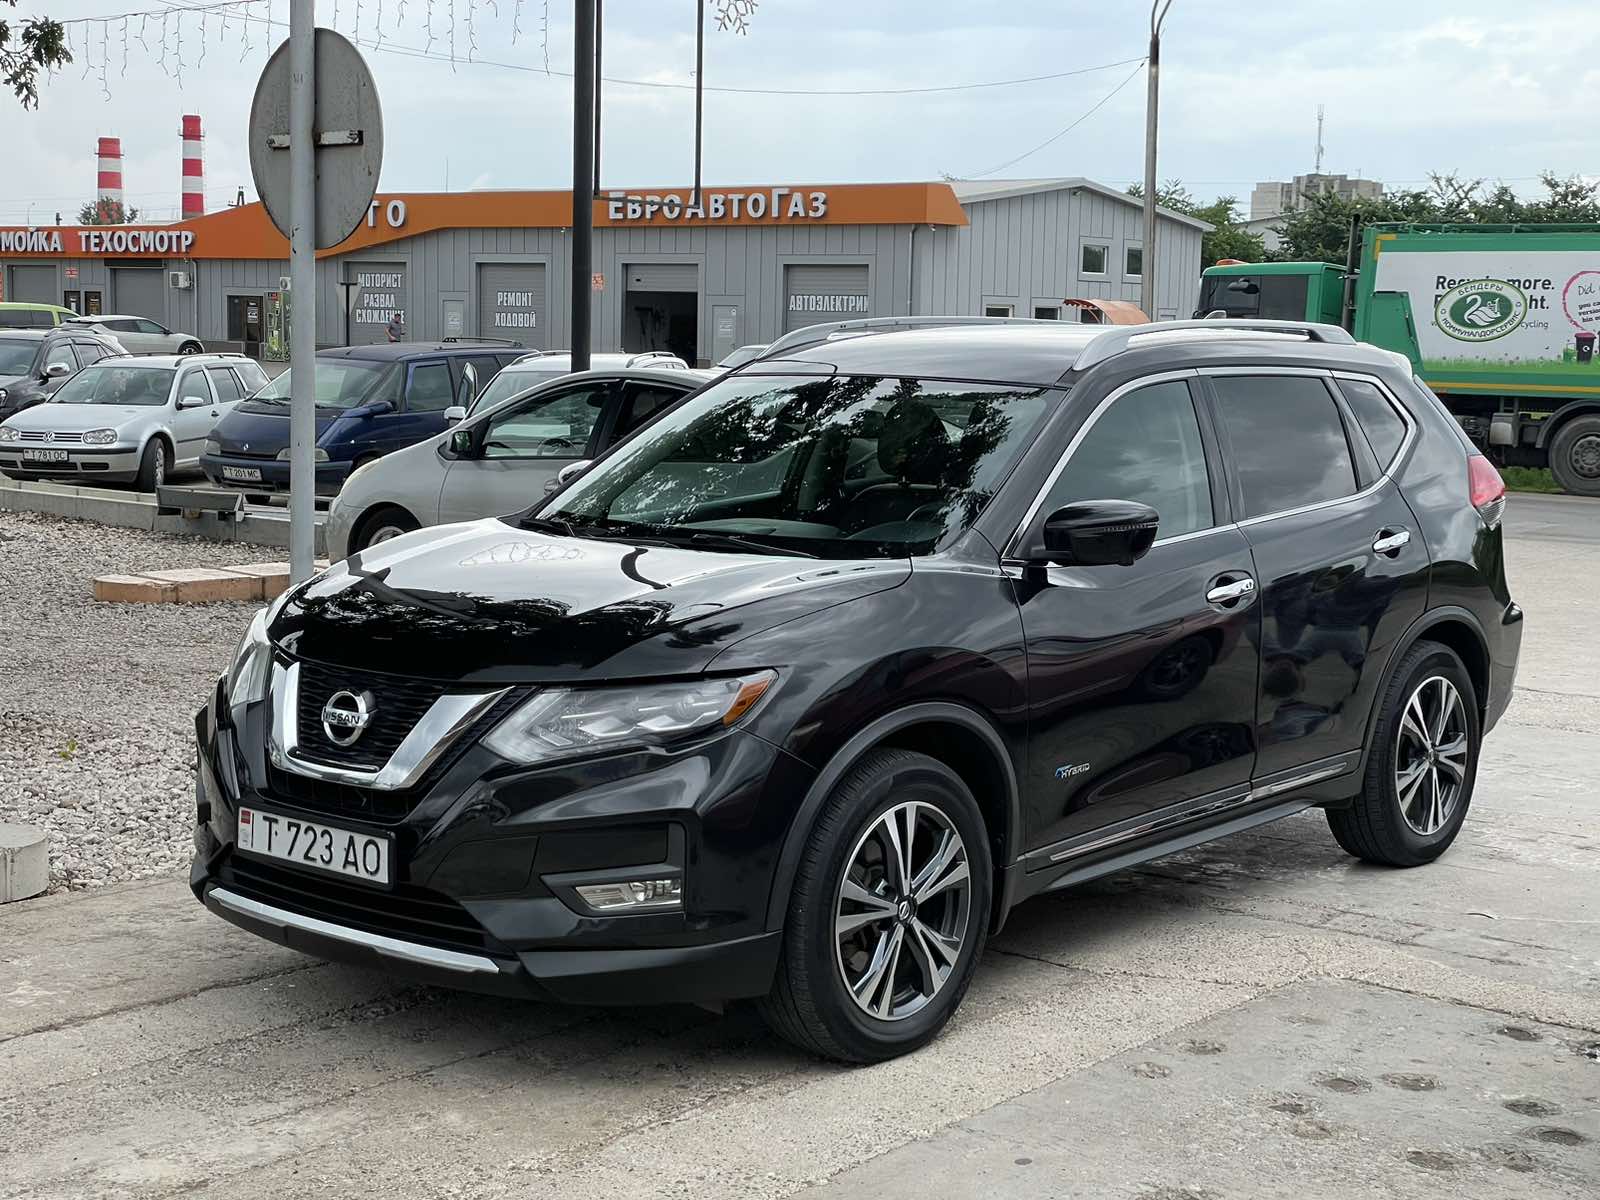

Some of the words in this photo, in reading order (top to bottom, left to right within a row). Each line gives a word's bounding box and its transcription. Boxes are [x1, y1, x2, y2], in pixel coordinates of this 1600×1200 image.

[0, 226, 65, 252] МОЙКА
[79, 230, 194, 252] ТЕХОСМОТР
[358, 273, 402, 288] МОТОРИСТ
[1458, 283, 1504, 296] БЕНДЕРЫ
[364, 293, 396, 308] РАЗВАЛ
[497, 292, 533, 307] РЕМОНТ
[495, 311, 536, 327] ХОДОВОЙ
[1442, 311, 1521, 338] КОММУНАЛДОРСЕРВИС
[263, 815, 279, 852] T
[287, 821, 334, 865] 723
[342, 834, 381, 876] AO
